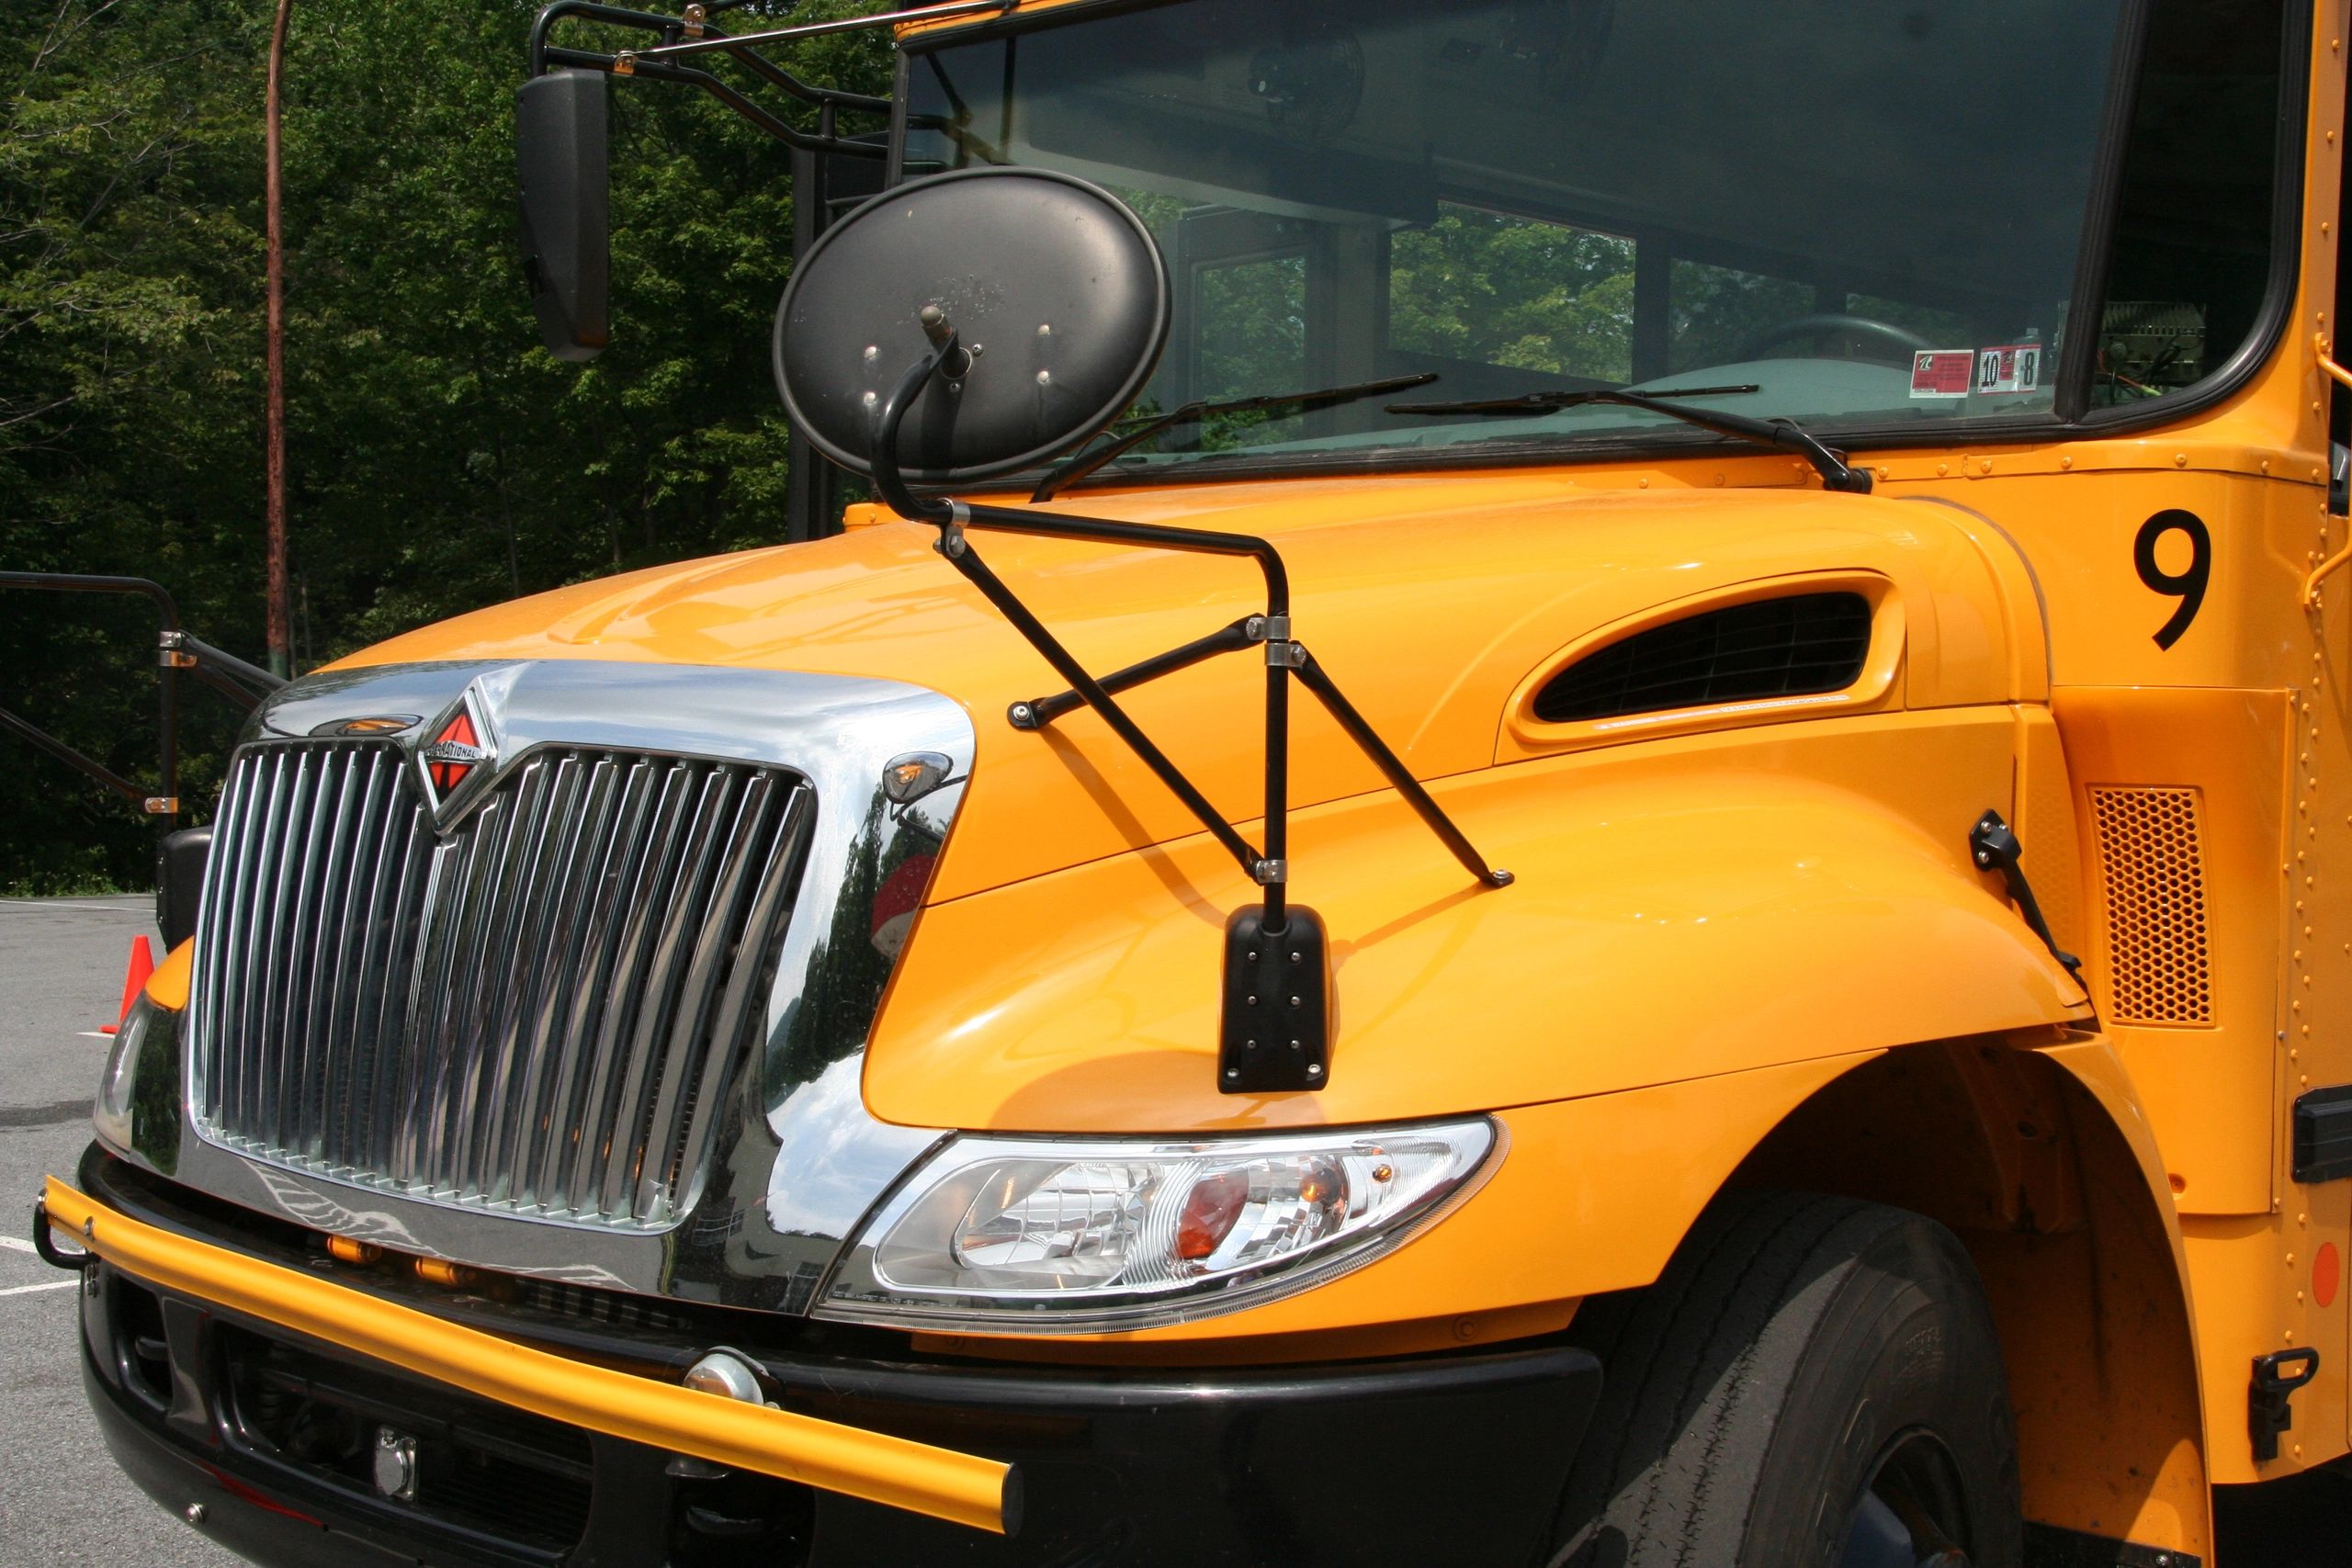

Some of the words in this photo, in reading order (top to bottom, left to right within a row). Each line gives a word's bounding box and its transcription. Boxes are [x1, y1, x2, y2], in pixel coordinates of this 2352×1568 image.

[1982, 354, 1998, 387] 10
[2023, 351, 2035, 386] 8
[2132, 508, 2211, 652] 9
[425, 741, 476, 759] TERNATIONAL
